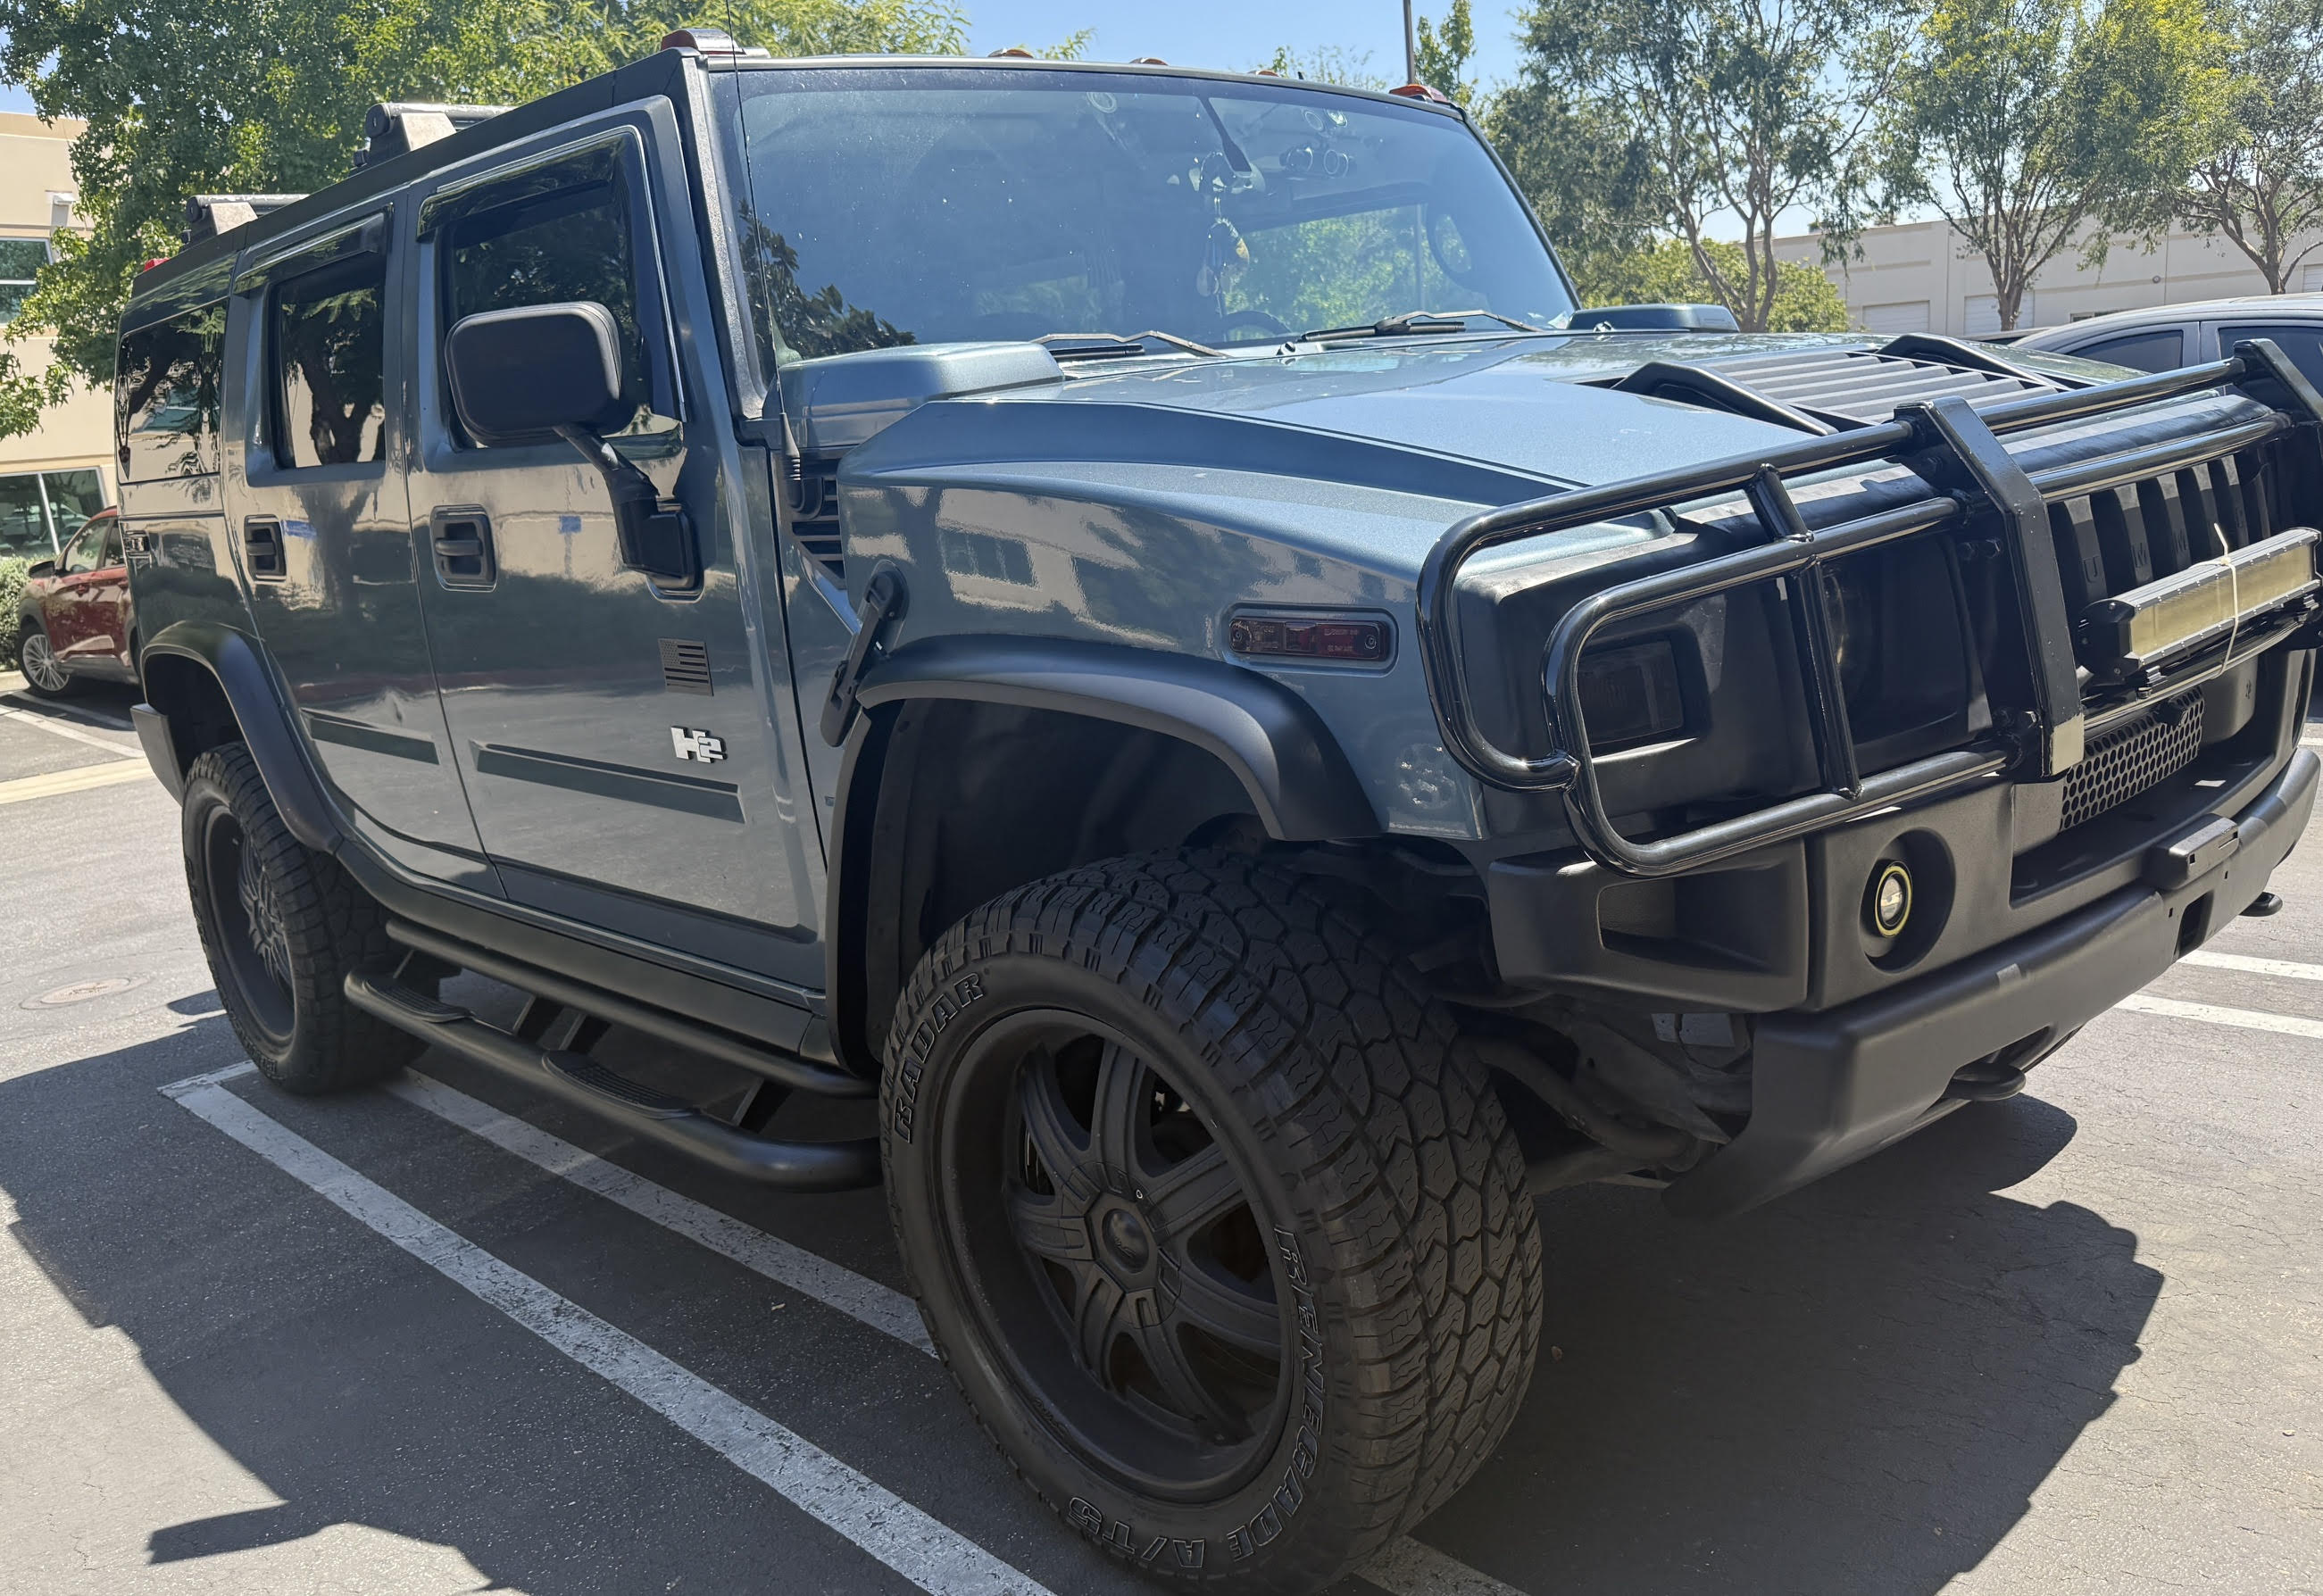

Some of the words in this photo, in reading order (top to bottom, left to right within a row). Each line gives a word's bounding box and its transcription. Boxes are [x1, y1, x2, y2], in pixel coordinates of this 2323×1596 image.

[670, 726, 728, 763] H2
[895, 972, 984, 1143] RADAR
[1226, 1226, 1326, 1563] RENEGADE
[1069, 1496, 1205, 1568] A/T5
